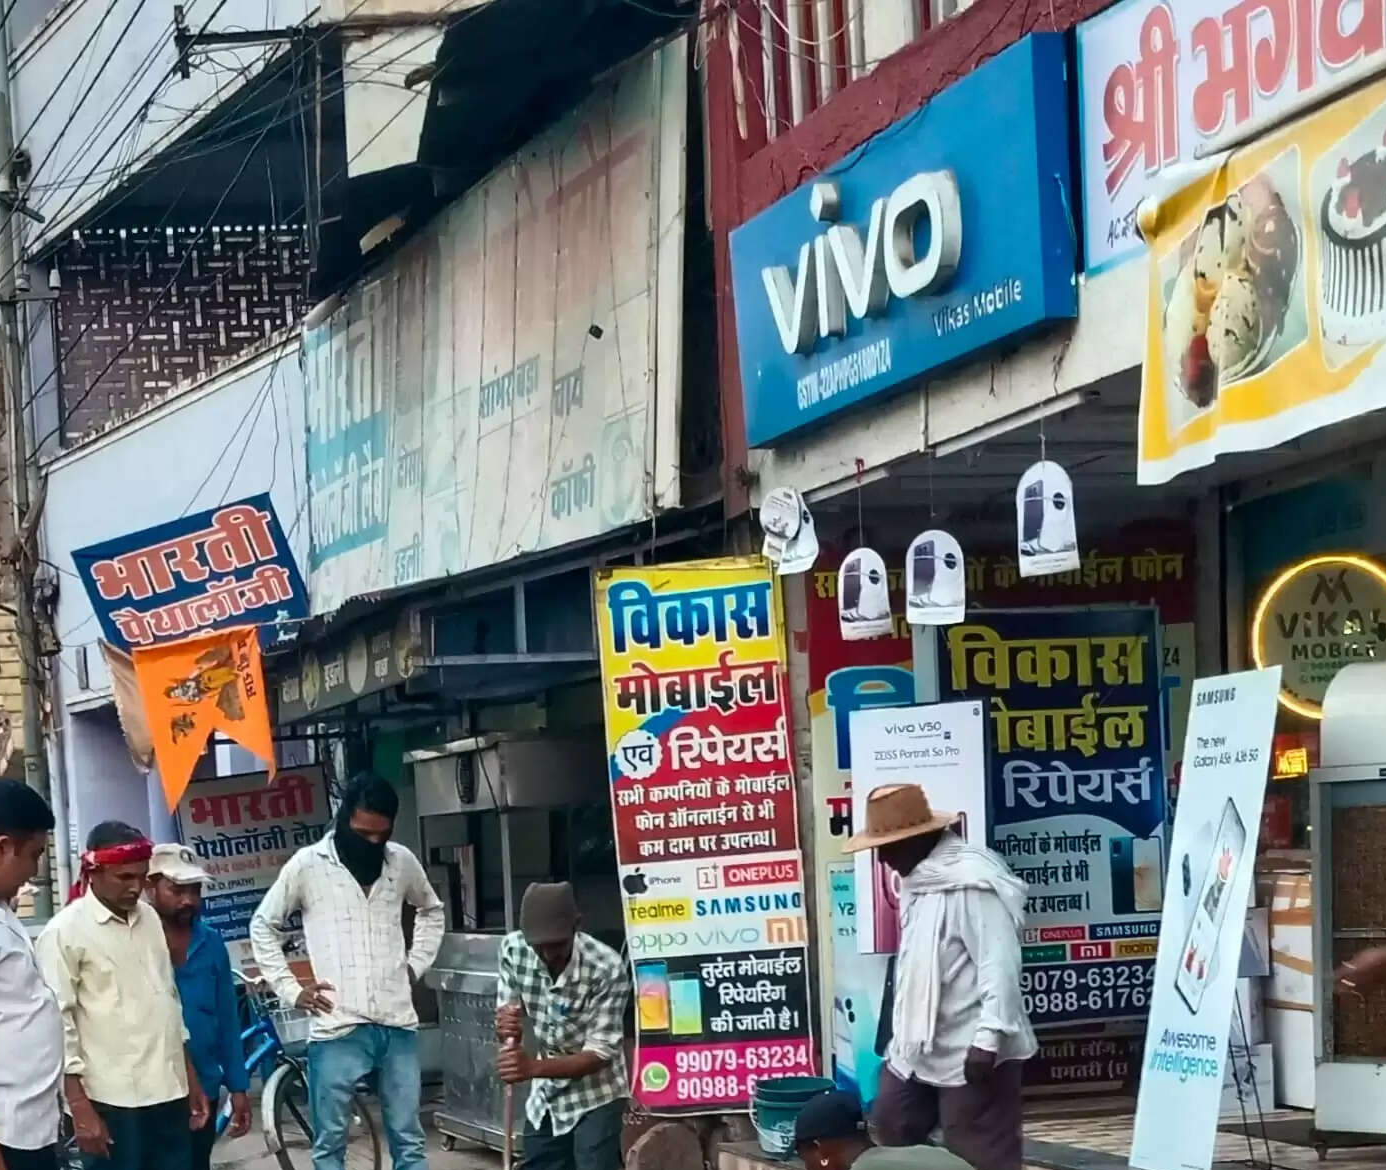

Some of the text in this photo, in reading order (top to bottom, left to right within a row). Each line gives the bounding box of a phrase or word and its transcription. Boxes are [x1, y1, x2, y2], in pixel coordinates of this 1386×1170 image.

[1102, 3, 1181, 201] श्री
[763, 170, 962, 354] vivo
[933, 277, 1022, 337] Vikas Mobile
[91, 504, 278, 600] भारती
[608, 579, 772, 653] विकास
[947, 625, 1148, 690] विकास
[614, 650, 779, 715] मोबाईल
[1196, 688, 1236, 707] SAMSUNG
[884, 724, 915, 735] vivo
[188, 774, 315, 828] भारती
[617, 771, 790, 806] सभी कम्पनियों के मोबाईल
[635, 809, 665, 831] फोन
[740, 800, 754, 822] से
[757, 798, 775, 820] भी
[638, 839, 665, 857] कम
[668, 836, 695, 853] दाम
[698, 834, 718, 851] पर
[649, 875, 681, 886] iPhone
[728, 863, 795, 883] ONEPLUS
[630, 902, 686, 920] realme
[694, 927, 760, 947] vivo
[1096, 923, 1158, 937] SAMSUNG
[700, 956, 736, 987] तुरंत
[711, 1013, 734, 1033] की
[737, 1010, 776, 1031] जाती
[1159, 1028, 1217, 1052] Awesome
[675, 1045, 808, 1073] 99079-63234
[1149, 1049, 1218, 1083] Intelligence
